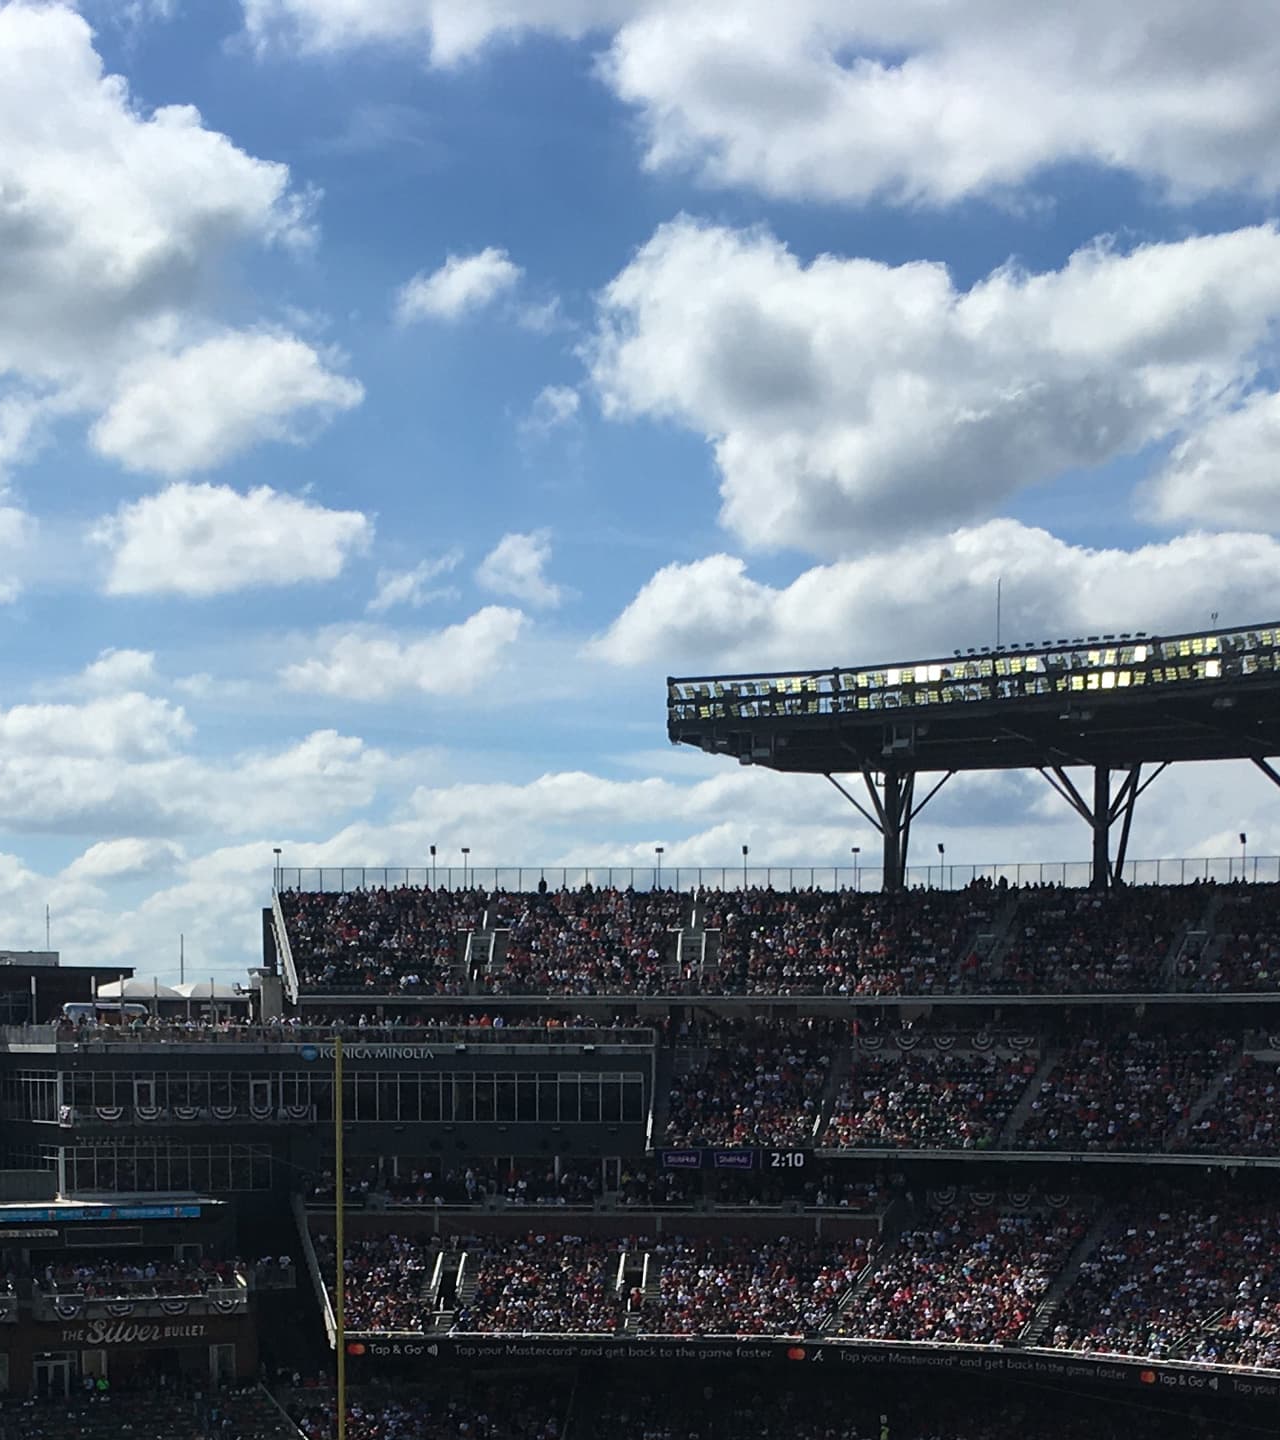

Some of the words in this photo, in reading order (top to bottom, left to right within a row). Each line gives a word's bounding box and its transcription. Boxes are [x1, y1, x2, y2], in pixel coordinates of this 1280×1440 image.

[375, 1047, 435, 1060] MINOLTA
[771, 1152, 805, 1168] 2:10
[63, 1330, 84, 1342] THE
[87, 1319, 161, 1344] Silver
[164, 1324, 205, 1338] BULLET
[369, 1344, 391, 1356] Tap
[393, 1344, 402, 1355] &
[478, 1347, 503, 1358] your
[580, 1346, 603, 1357] and
[604, 1347, 625, 1360] get
[628, 1346, 657, 1357] back
[659, 1347, 673, 1357] to
[675, 1346, 697, 1358] the
[699, 1348, 733, 1361] game
